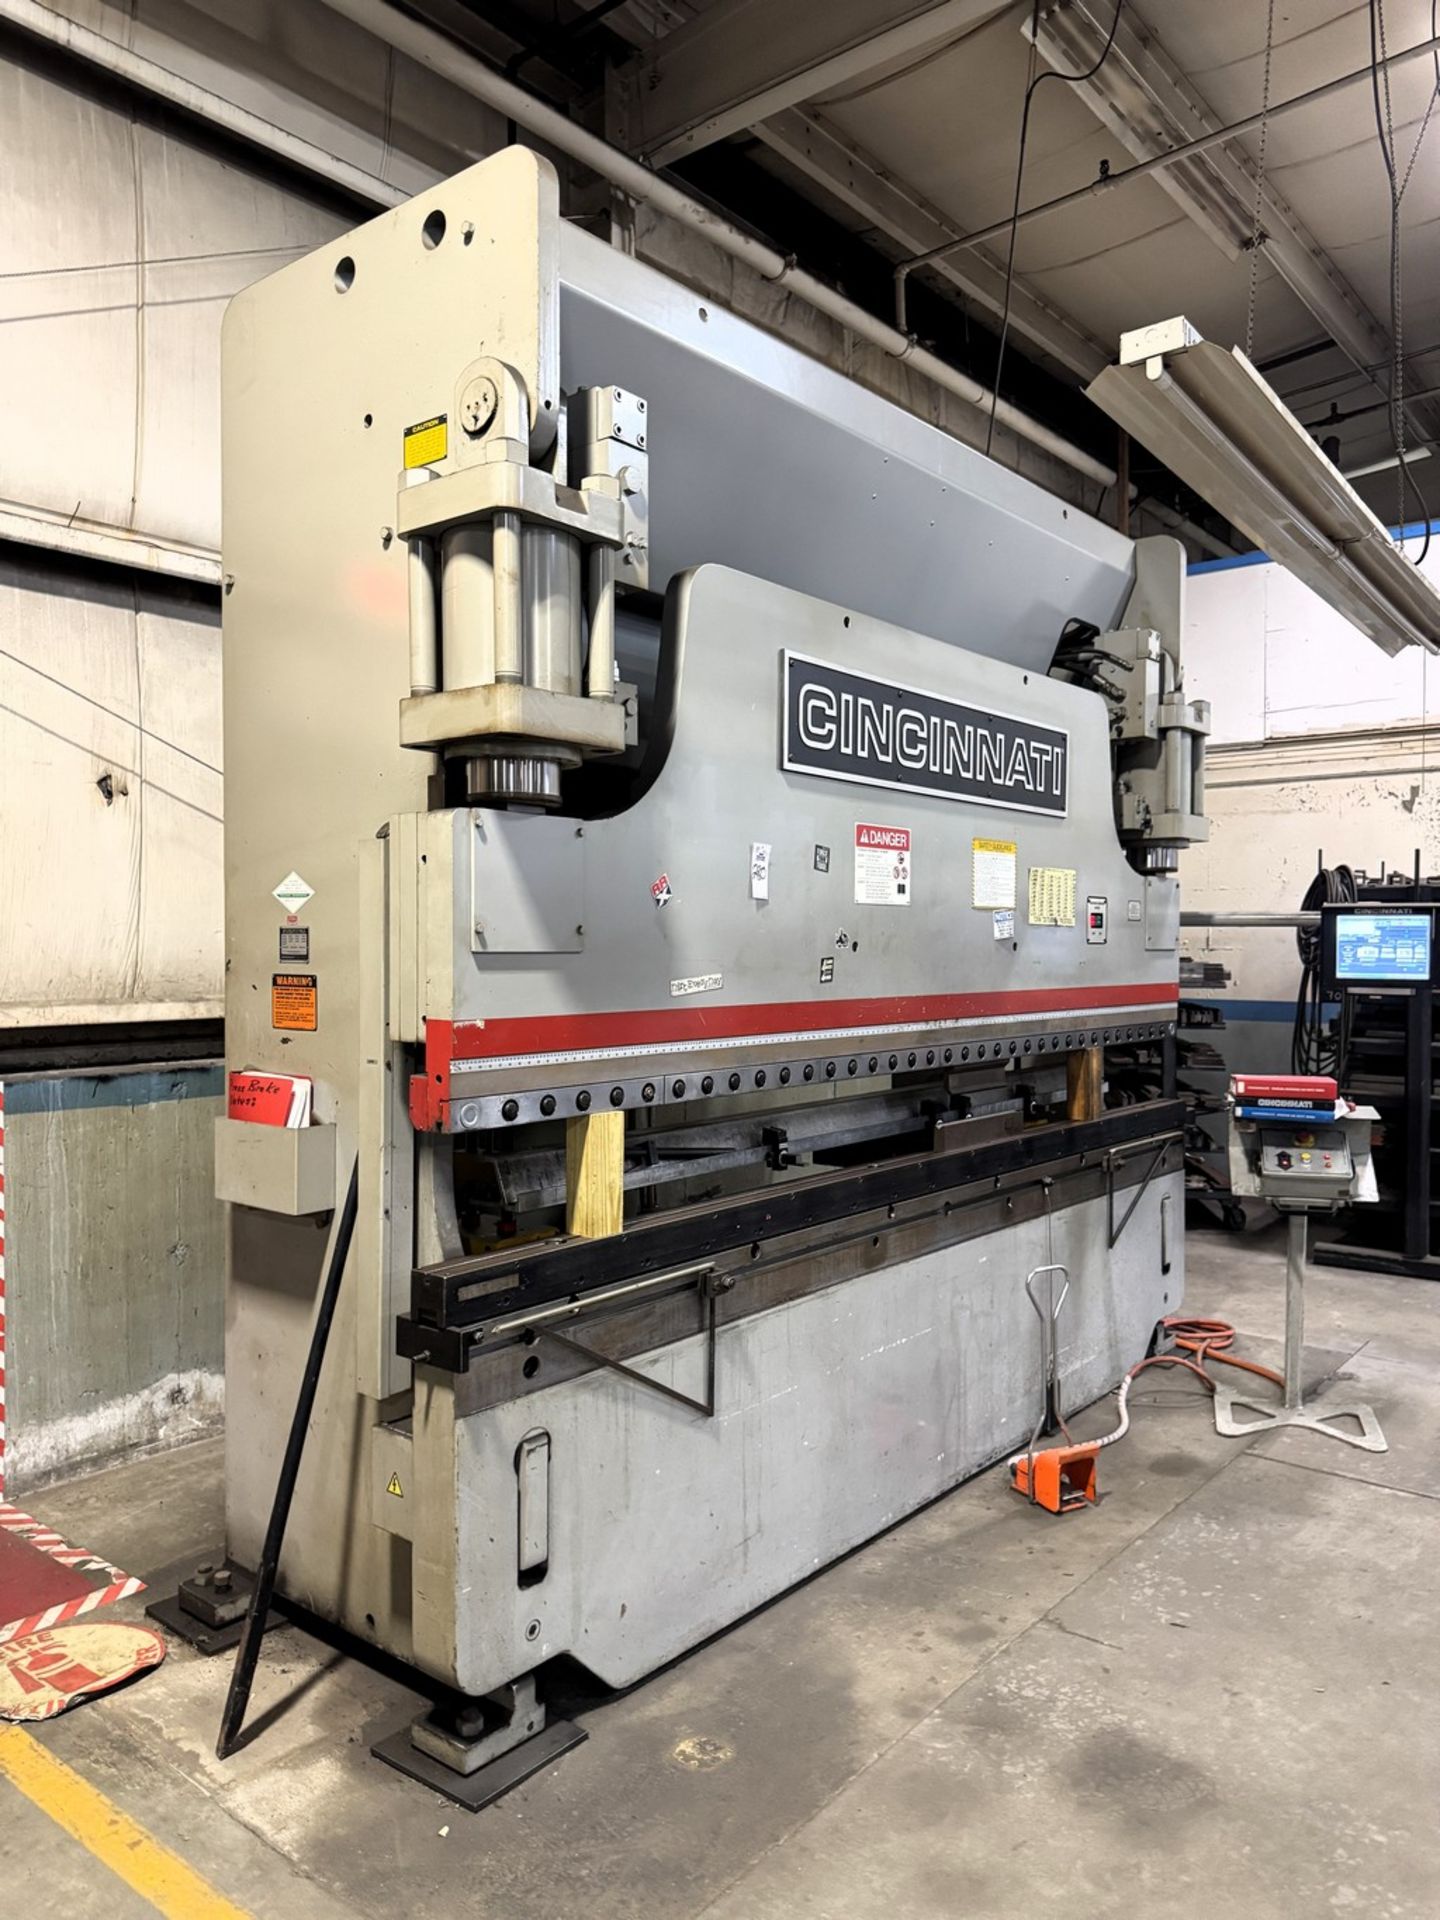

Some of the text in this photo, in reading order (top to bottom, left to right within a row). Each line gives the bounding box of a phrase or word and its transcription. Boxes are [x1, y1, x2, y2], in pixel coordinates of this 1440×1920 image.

[412, 419, 439, 433] CAUTION
[798, 682, 1062, 796] CINCINNATI
[869, 830, 908, 847] DANGER
[275, 975, 313, 987] WARNING
[247, 1079, 281, 1094] Brake
[1257, 1098, 1313, 1109] CINCINNATI
